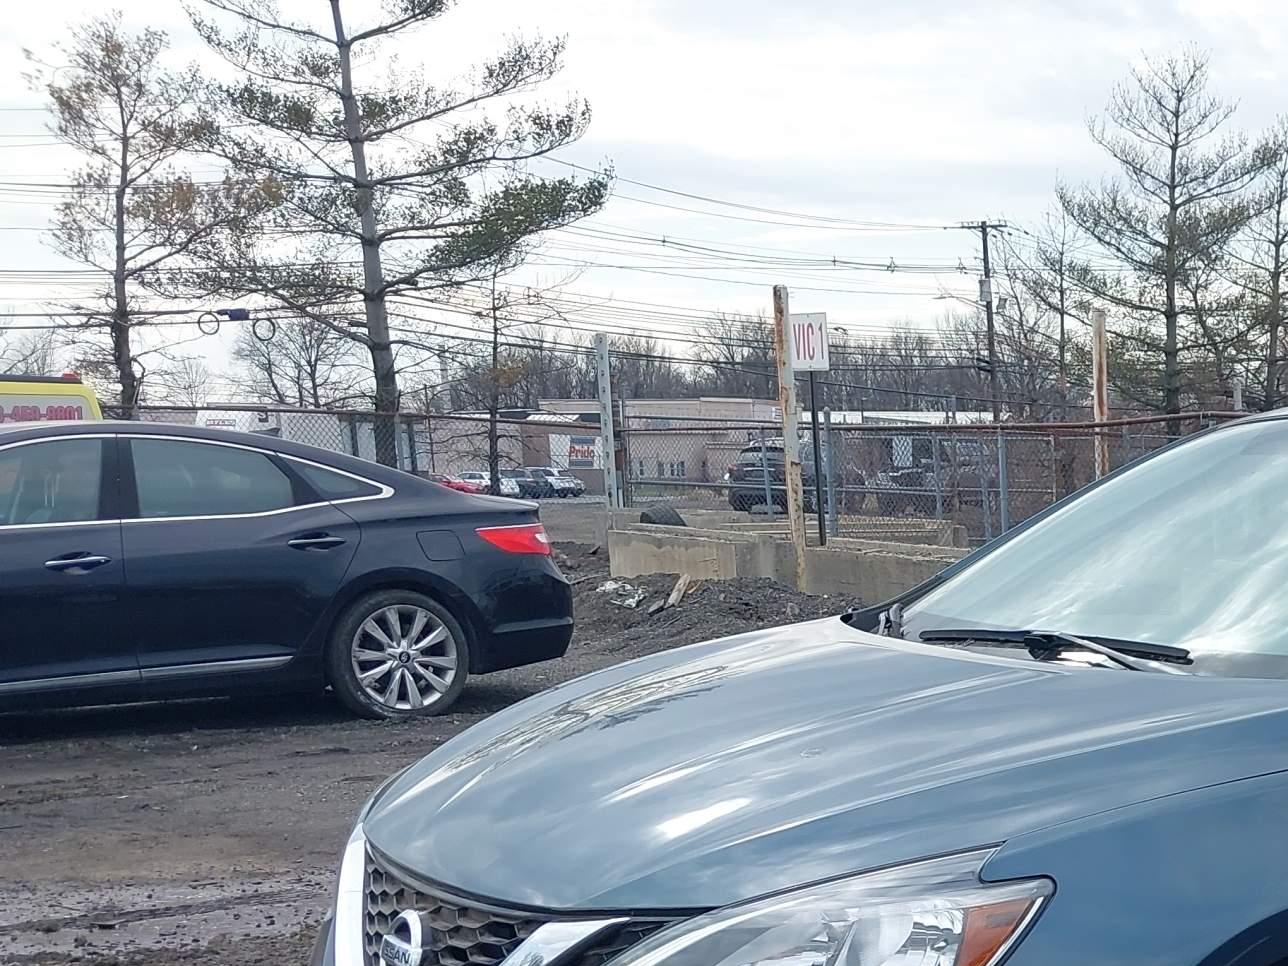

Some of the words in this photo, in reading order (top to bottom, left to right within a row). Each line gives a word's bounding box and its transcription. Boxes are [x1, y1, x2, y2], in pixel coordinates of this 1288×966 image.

[792, 322, 815, 361] VIC
[818, 321, 825, 361] 1
[569, 445, 595, 459] Pride
